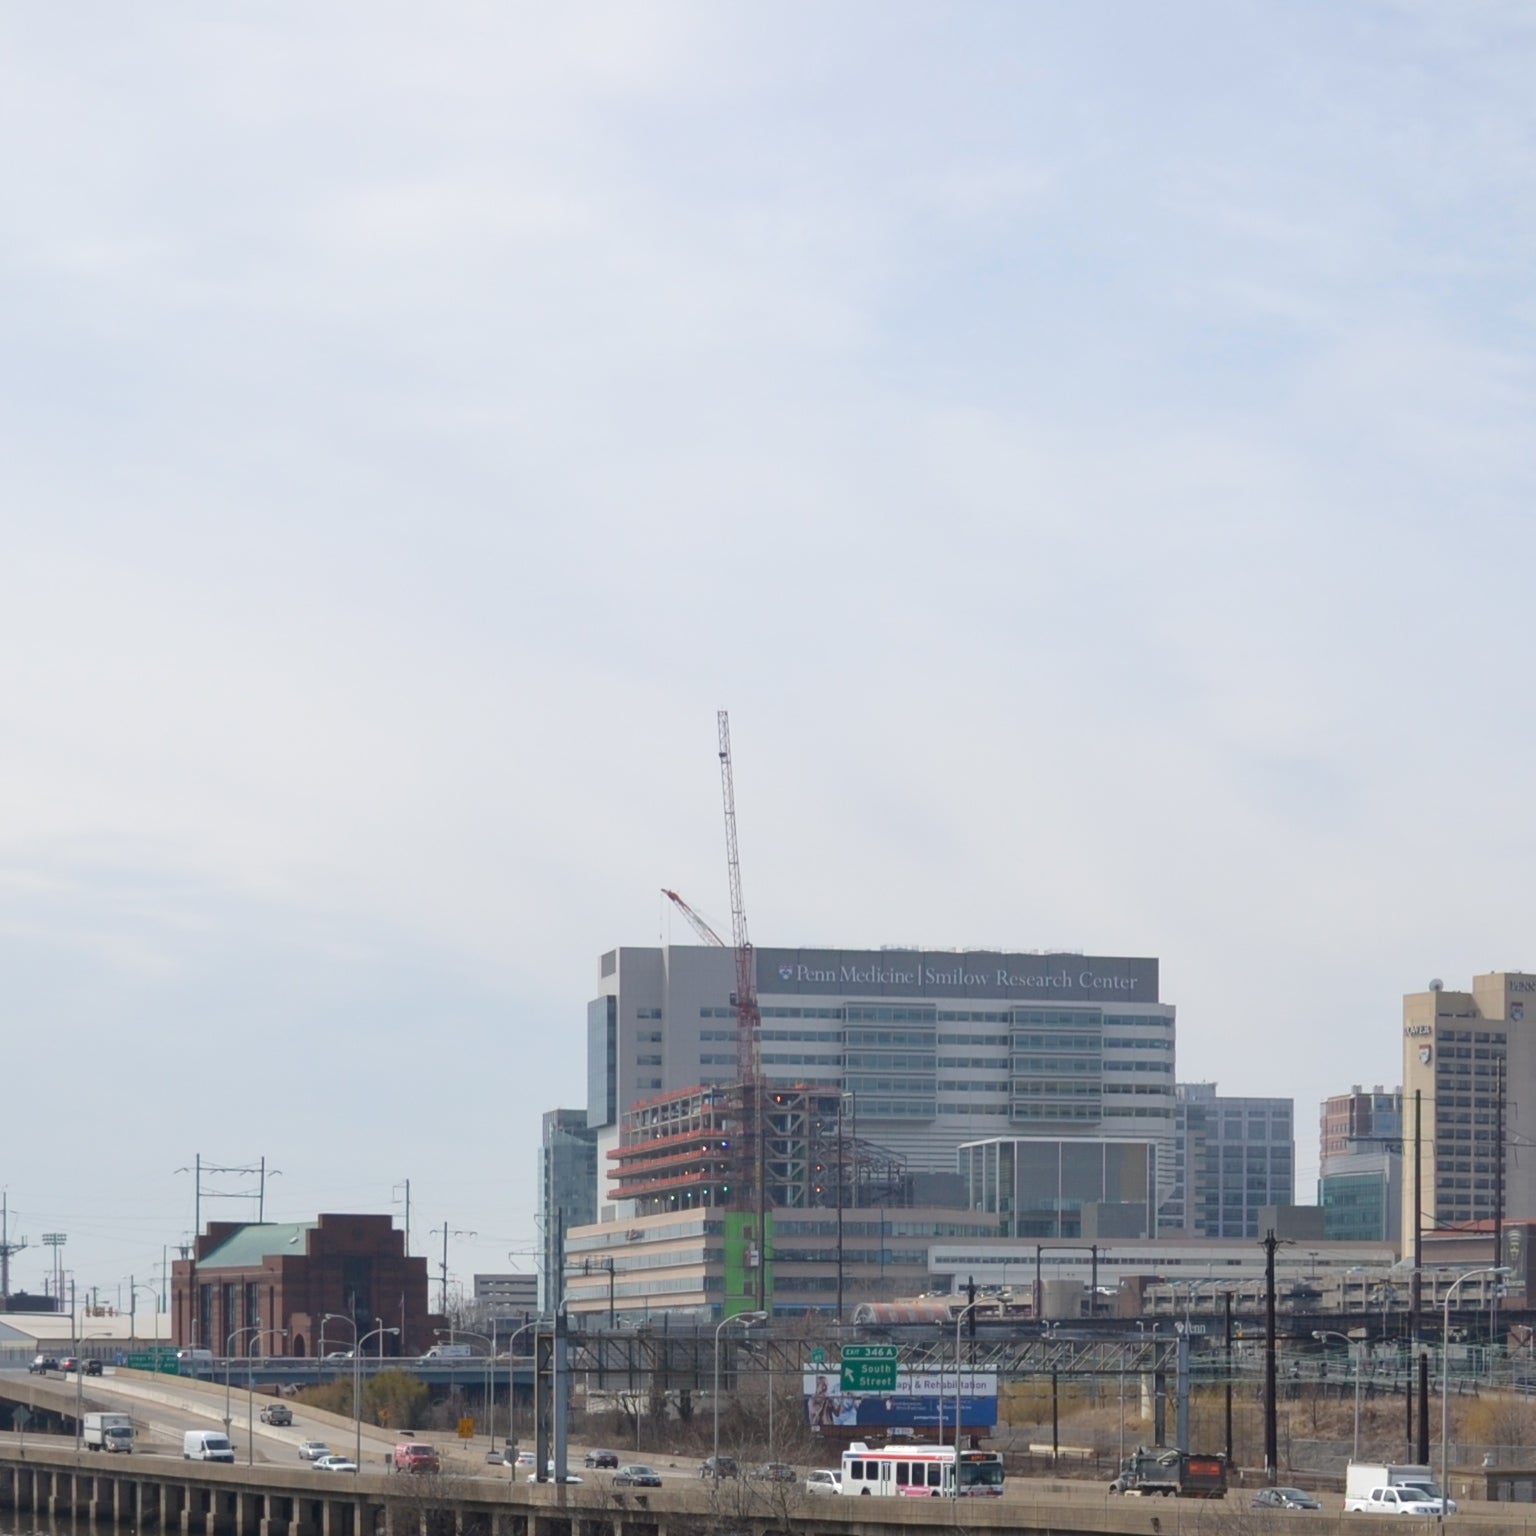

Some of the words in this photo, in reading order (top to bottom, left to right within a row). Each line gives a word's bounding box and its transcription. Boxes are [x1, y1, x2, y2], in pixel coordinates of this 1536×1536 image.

[797, 964, 836, 982] Penn
[839, 964, 914, 984] Medicine
[925, 967, 990, 986] Smilow
[996, 969, 1072, 988] Research
[1079, 972, 1138, 989] Center
[865, 1348, 884, 1356] 346
[886, 1348, 893, 1356] A
[861, 1364, 891, 1374] South
[859, 1377, 891, 1386] Street
